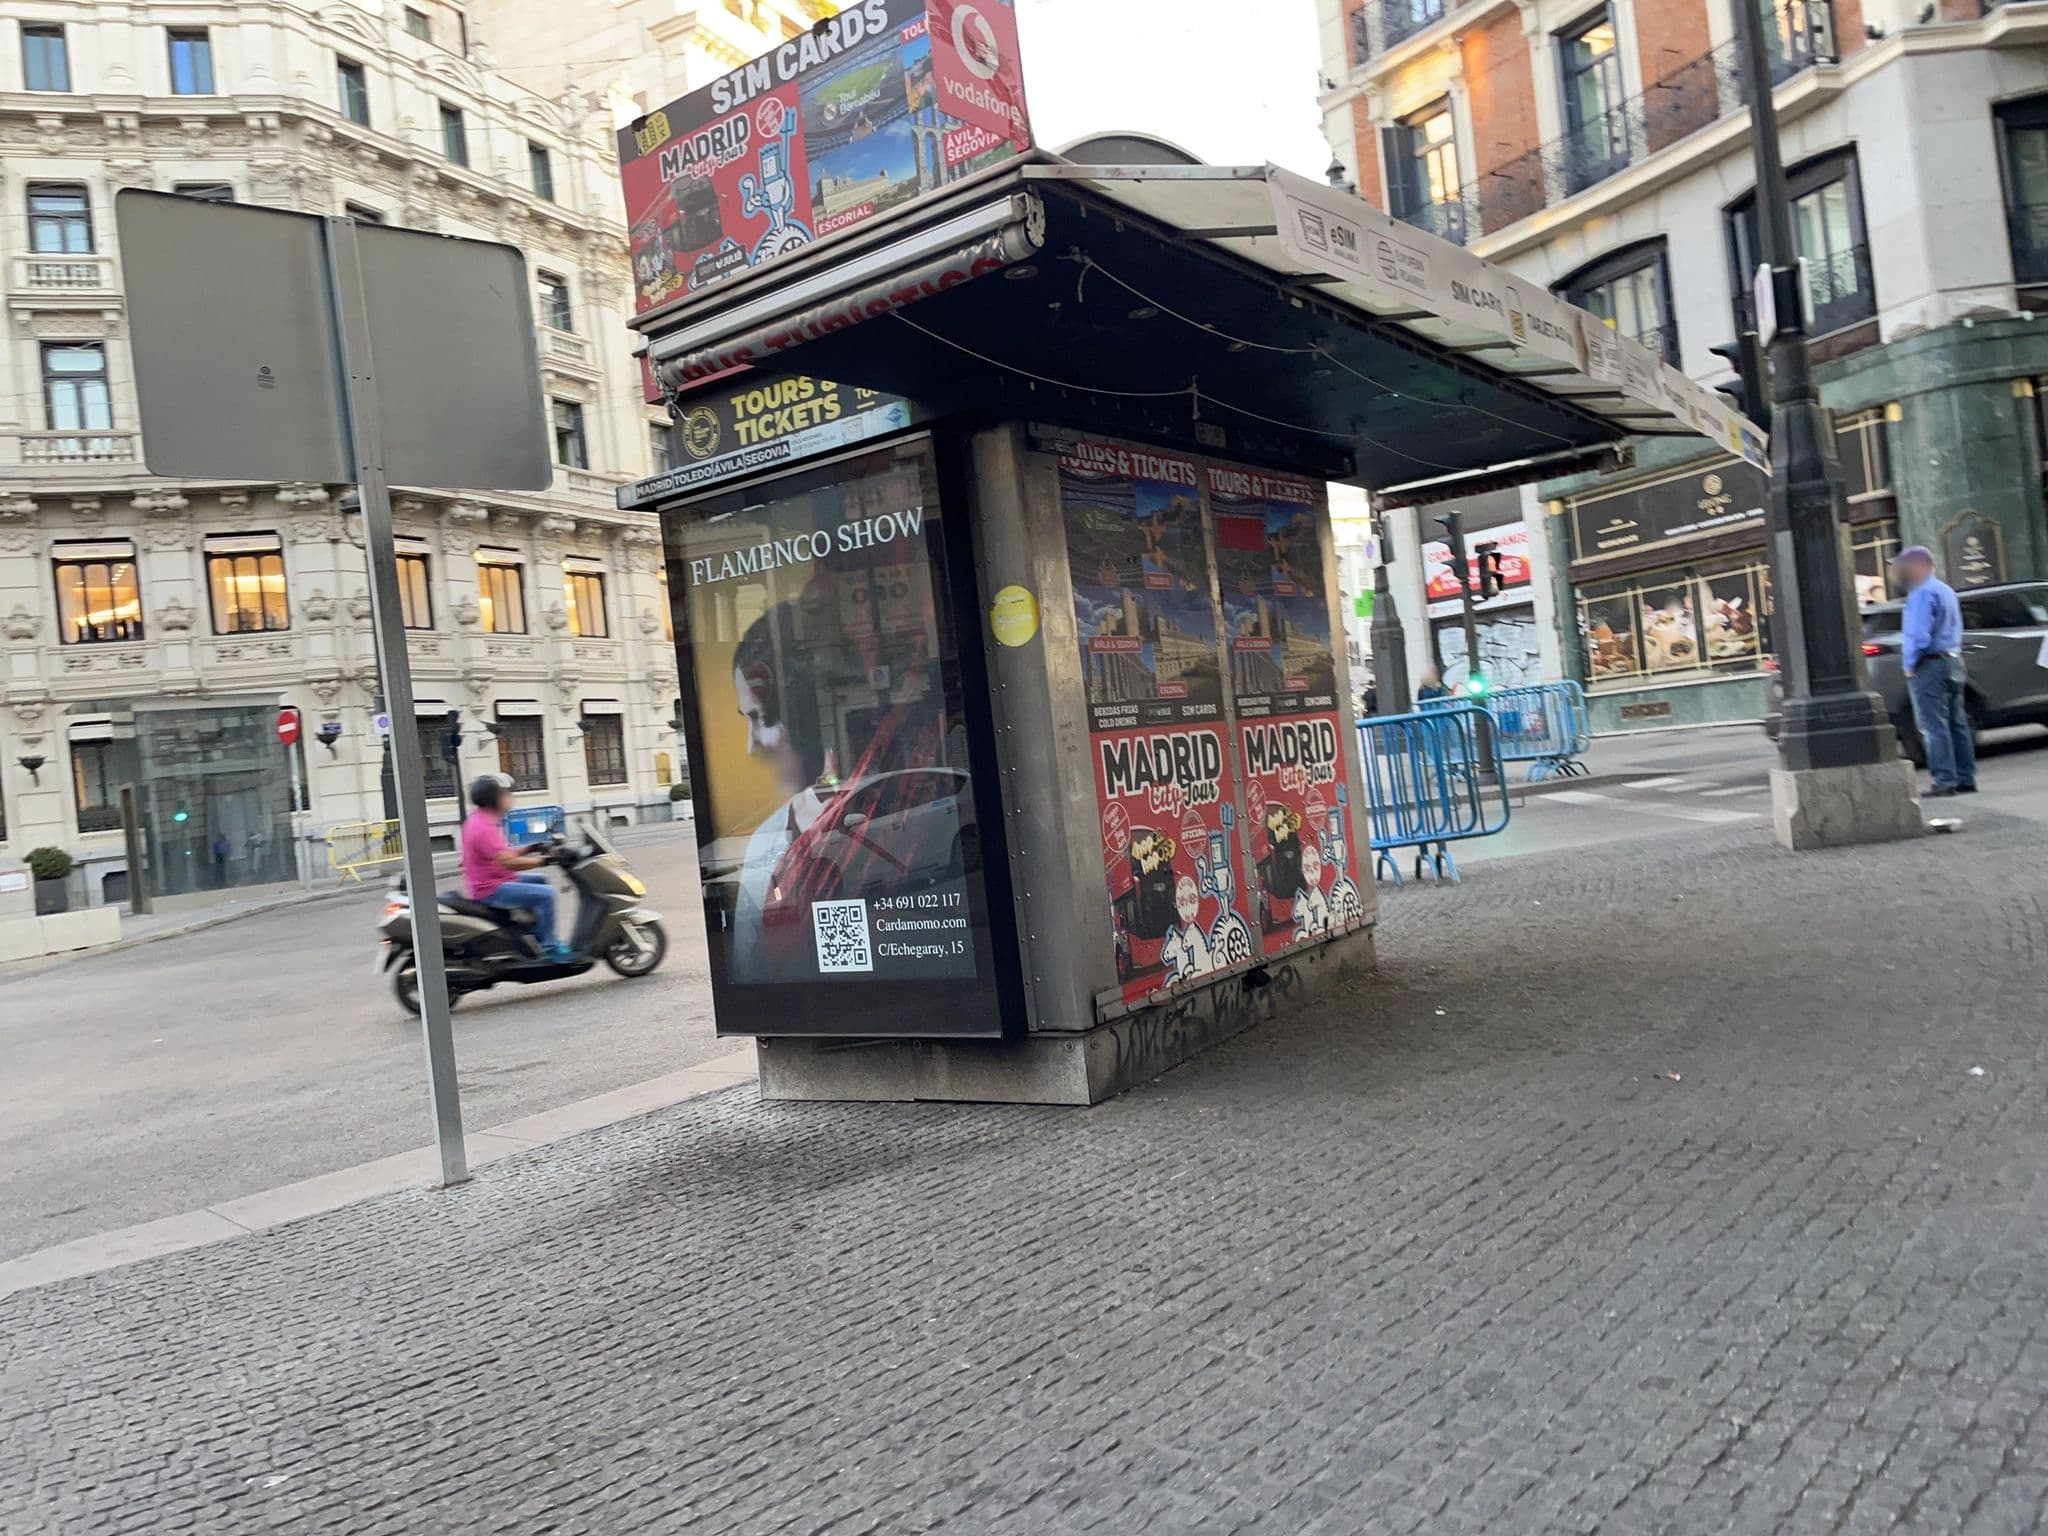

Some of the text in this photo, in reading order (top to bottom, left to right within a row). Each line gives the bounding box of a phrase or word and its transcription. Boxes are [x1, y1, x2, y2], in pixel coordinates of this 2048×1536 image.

[711, 0, 888, 114] SIM CARDS
[944, 77, 1022, 125] vodafone
[660, 113, 749, 181] MADRID
[947, 127, 983, 149] ÁVILA
[947, 134, 1000, 163] SEGOVIA
[818, 206, 872, 234] ESCORIAL
[1330, 225, 1358, 252] eSIM
[731, 376, 814, 419] TOURS
[734, 394, 842, 446] TICKETS
[636, 478, 672, 499] MADRID
[674, 466, 712, 487] TOLEDO
[714, 457, 744, 476] ÁVILA
[745, 443, 790, 466] SEGOVIA
[1117, 450, 1131, 476] &
[1131, 453, 1197, 486] TICKETS
[1208, 467, 1250, 496] TOURS
[1251, 474, 1262, 497] &
[689, 506, 924, 587] FLAMENCO SHOW
[1098, 717, 1116, 729] COLD
[1181, 706, 1194, 716] SIM
[1195, 704, 1217, 715] CARDS
[1101, 731, 1222, 797] MADRID
[1244, 719, 1337, 777] MADRID
[1279, 763, 1335, 795] City Tour
[1150, 783, 1185, 817] City
[1184, 779, 1218, 808] Tour
[874, 893, 960, 911] +34 691 022 117
[876, 917, 967, 932] Cardamomo.com
[878, 941, 964, 958] C/Echegaray, 15
